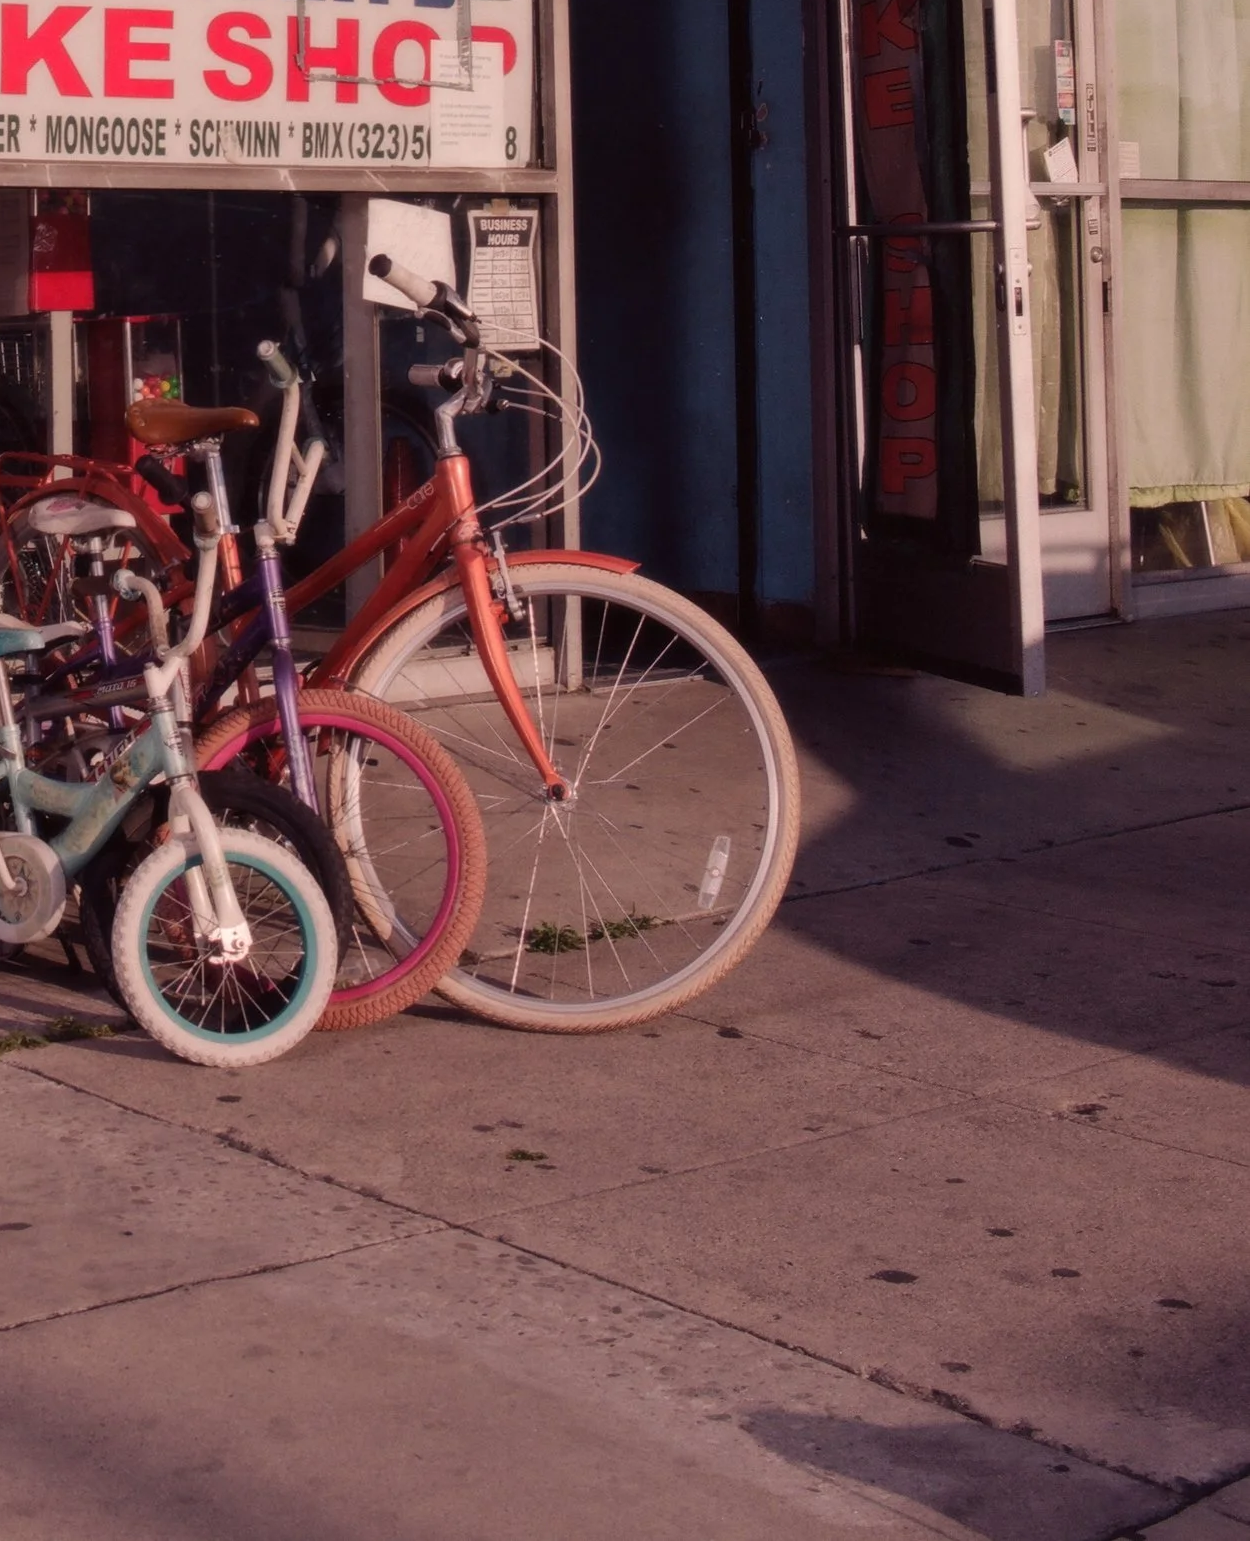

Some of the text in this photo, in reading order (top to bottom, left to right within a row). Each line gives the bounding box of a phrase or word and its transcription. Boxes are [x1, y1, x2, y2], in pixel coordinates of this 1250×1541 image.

[45, 115, 167, 156] MONGOOSE
[303, 122, 344, 158] BMX
[480, 218, 527, 231] BUSINESS
[487, 234, 520, 246] HOURS
[881, 212, 937, 494] SHOP
